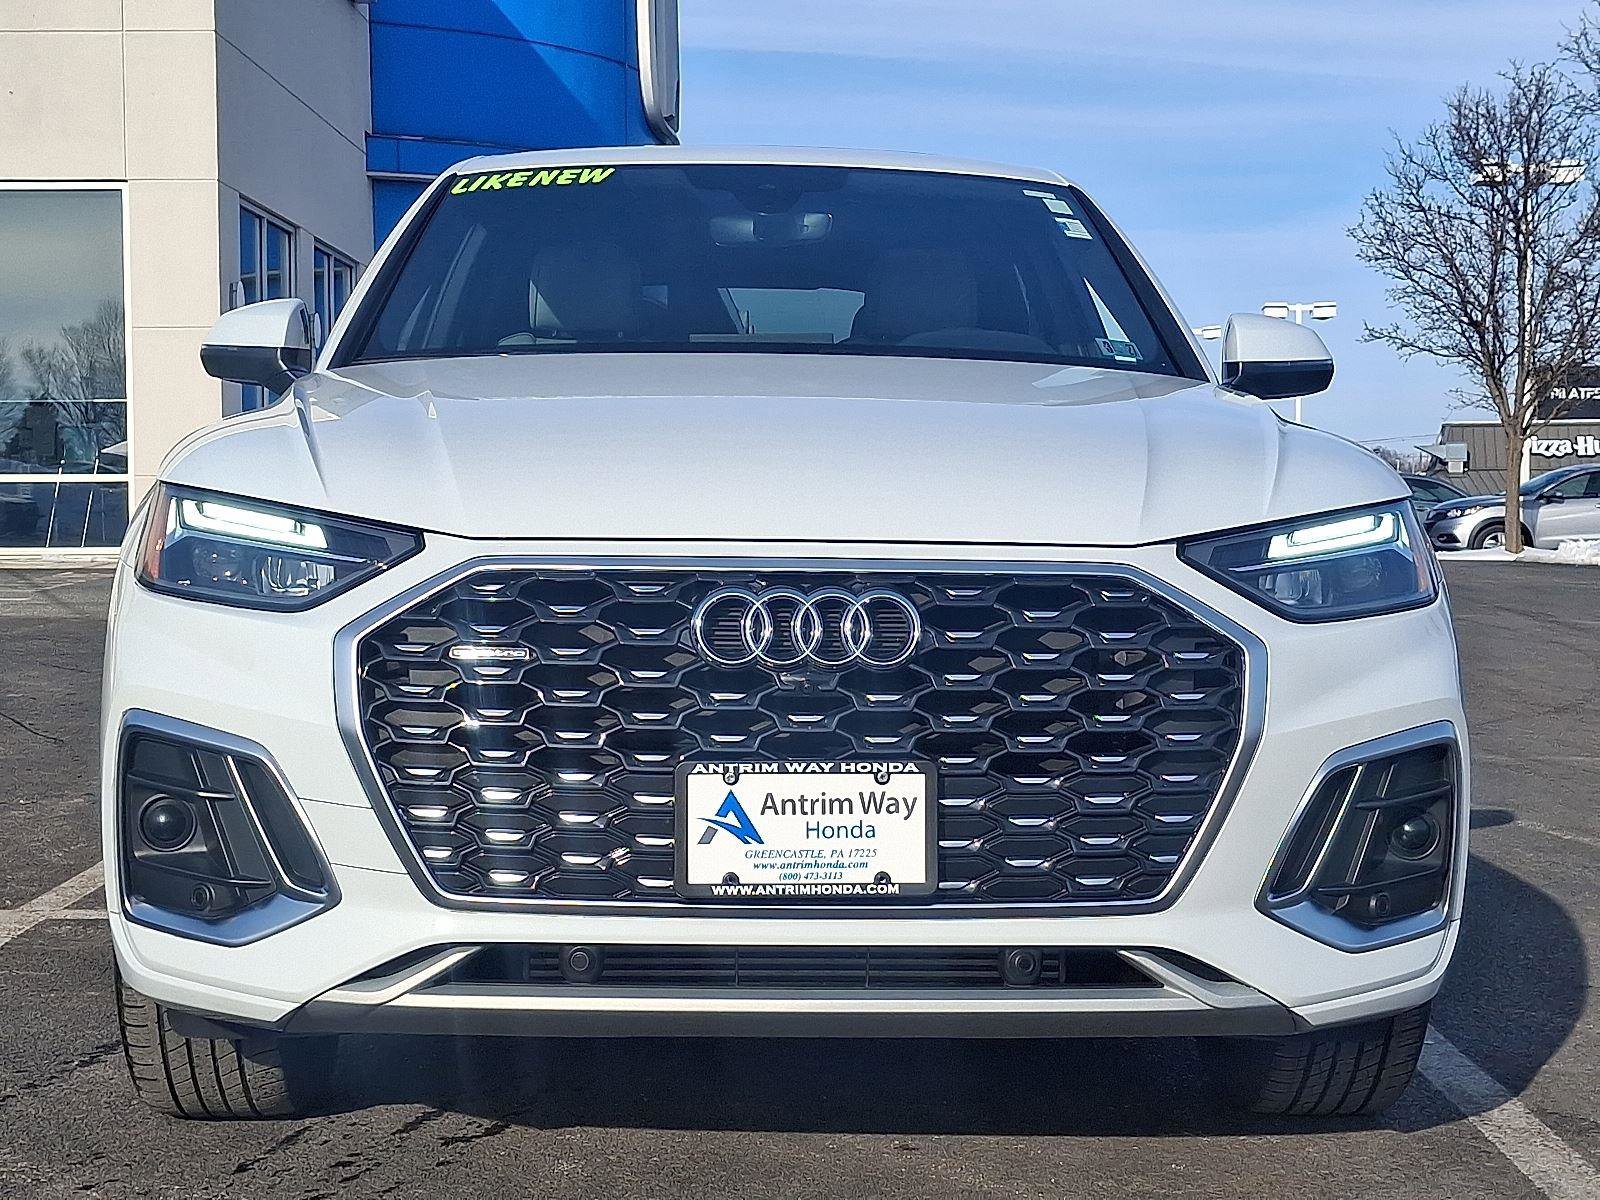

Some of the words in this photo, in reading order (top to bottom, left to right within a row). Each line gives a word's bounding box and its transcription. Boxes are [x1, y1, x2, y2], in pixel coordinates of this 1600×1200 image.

[1523, 435, 1573, 457] izza
[691, 762, 779, 774] ANTRIM
[784, 762, 836, 773] WAY
[839, 762, 920, 773] HONDA
[760, 791, 853, 816] Antrim
[858, 791, 918, 821] Way
[806, 820, 876, 839] Honda
[744, 849, 826, 860] GREENCASTLE,
[830, 849, 845, 859] PA
[848, 848, 878, 858] 17225
[752, 859, 869, 870] www.antrimhonda.com
[778, 872, 802, 882] (800)
[803, 871, 843, 880] 473-3113
[710, 884, 900, 895] WWW.ANTRIMHONDA.COM
